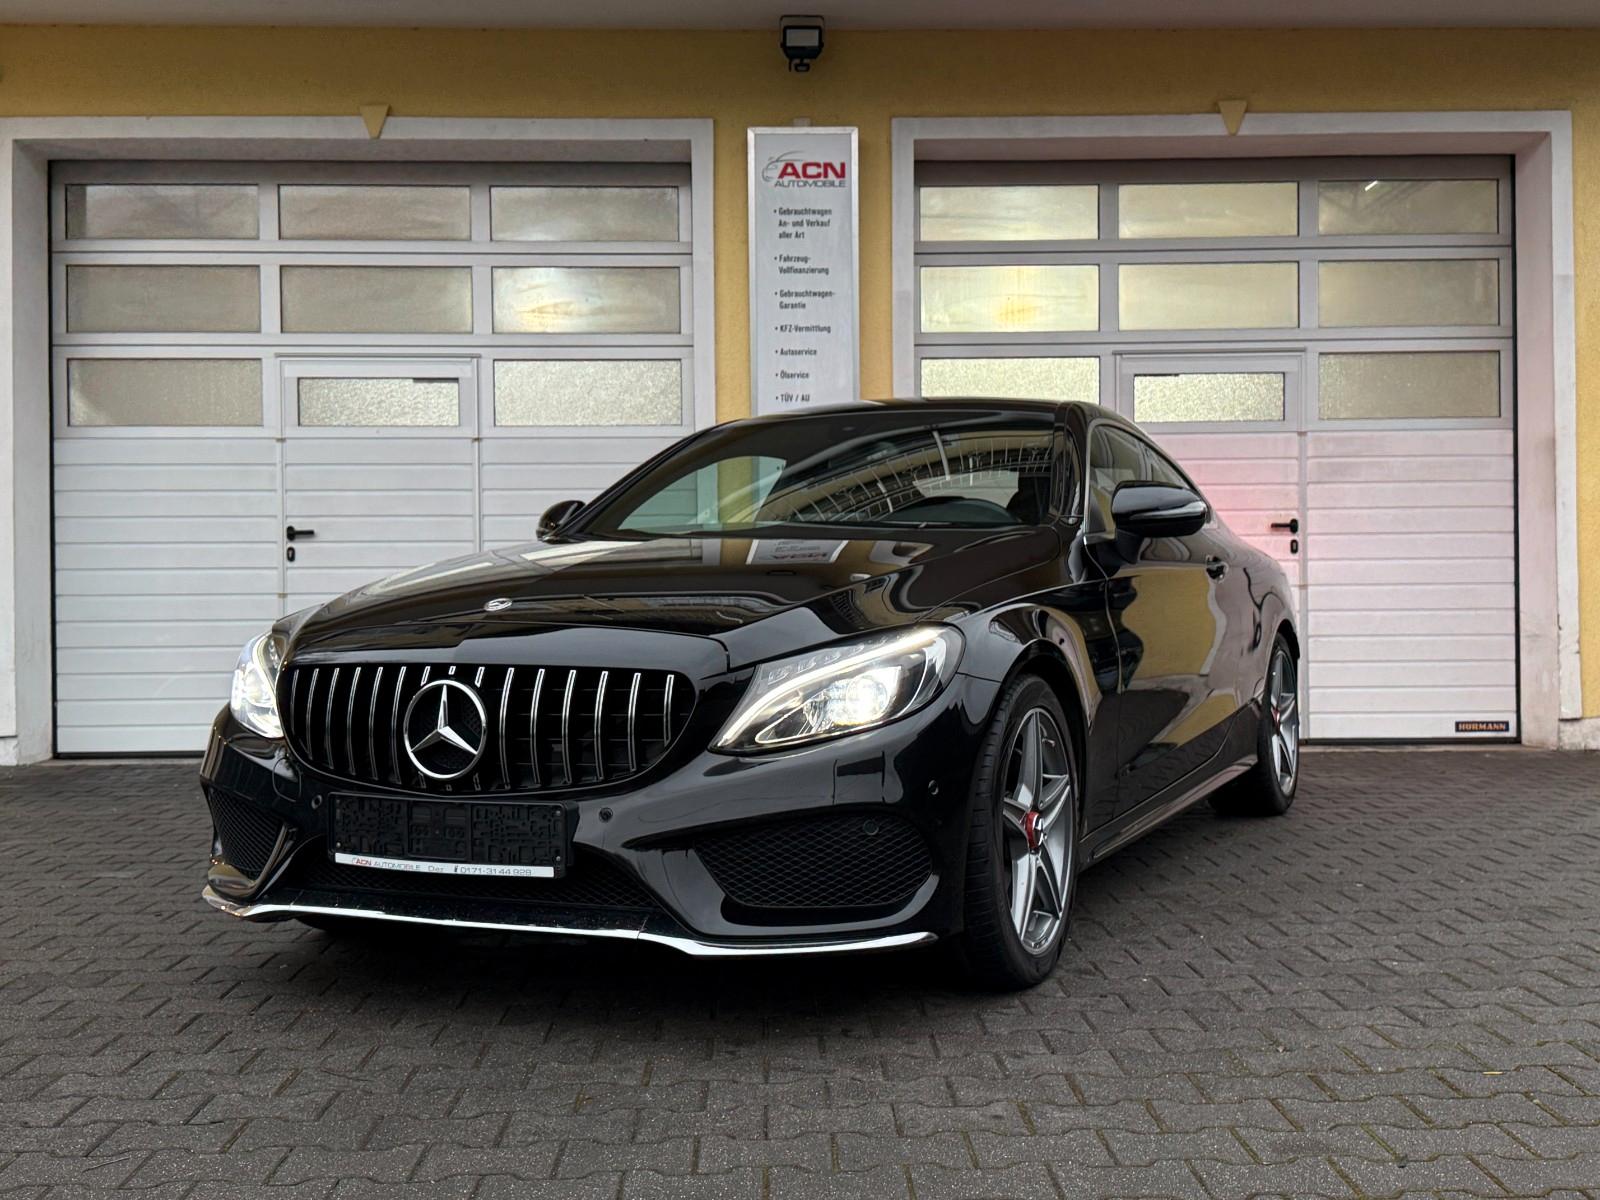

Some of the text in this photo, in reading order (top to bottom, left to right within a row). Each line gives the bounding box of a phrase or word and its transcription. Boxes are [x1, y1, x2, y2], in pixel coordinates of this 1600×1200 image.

[777, 161, 846, 179] ACN
[774, 180, 846, 188] AUTOMOBILE
[778, 207, 832, 216] Gebrauchtwagen
[778, 219, 831, 227] An- und Verkauf
[778, 231, 805, 239] aller Art
[779, 254, 811, 264] Fahrzeug-
[779, 266, 829, 275] Vollfinanzierung
[779, 301, 806, 309] Garantie
[780, 324, 831, 333] KFZ-Vermittlung
[780, 348, 817, 356] Autoservice
[780, 370, 809, 379] Ölservice
[780, 393, 793, 402] TÜV
[801, 394, 810, 402] AU
